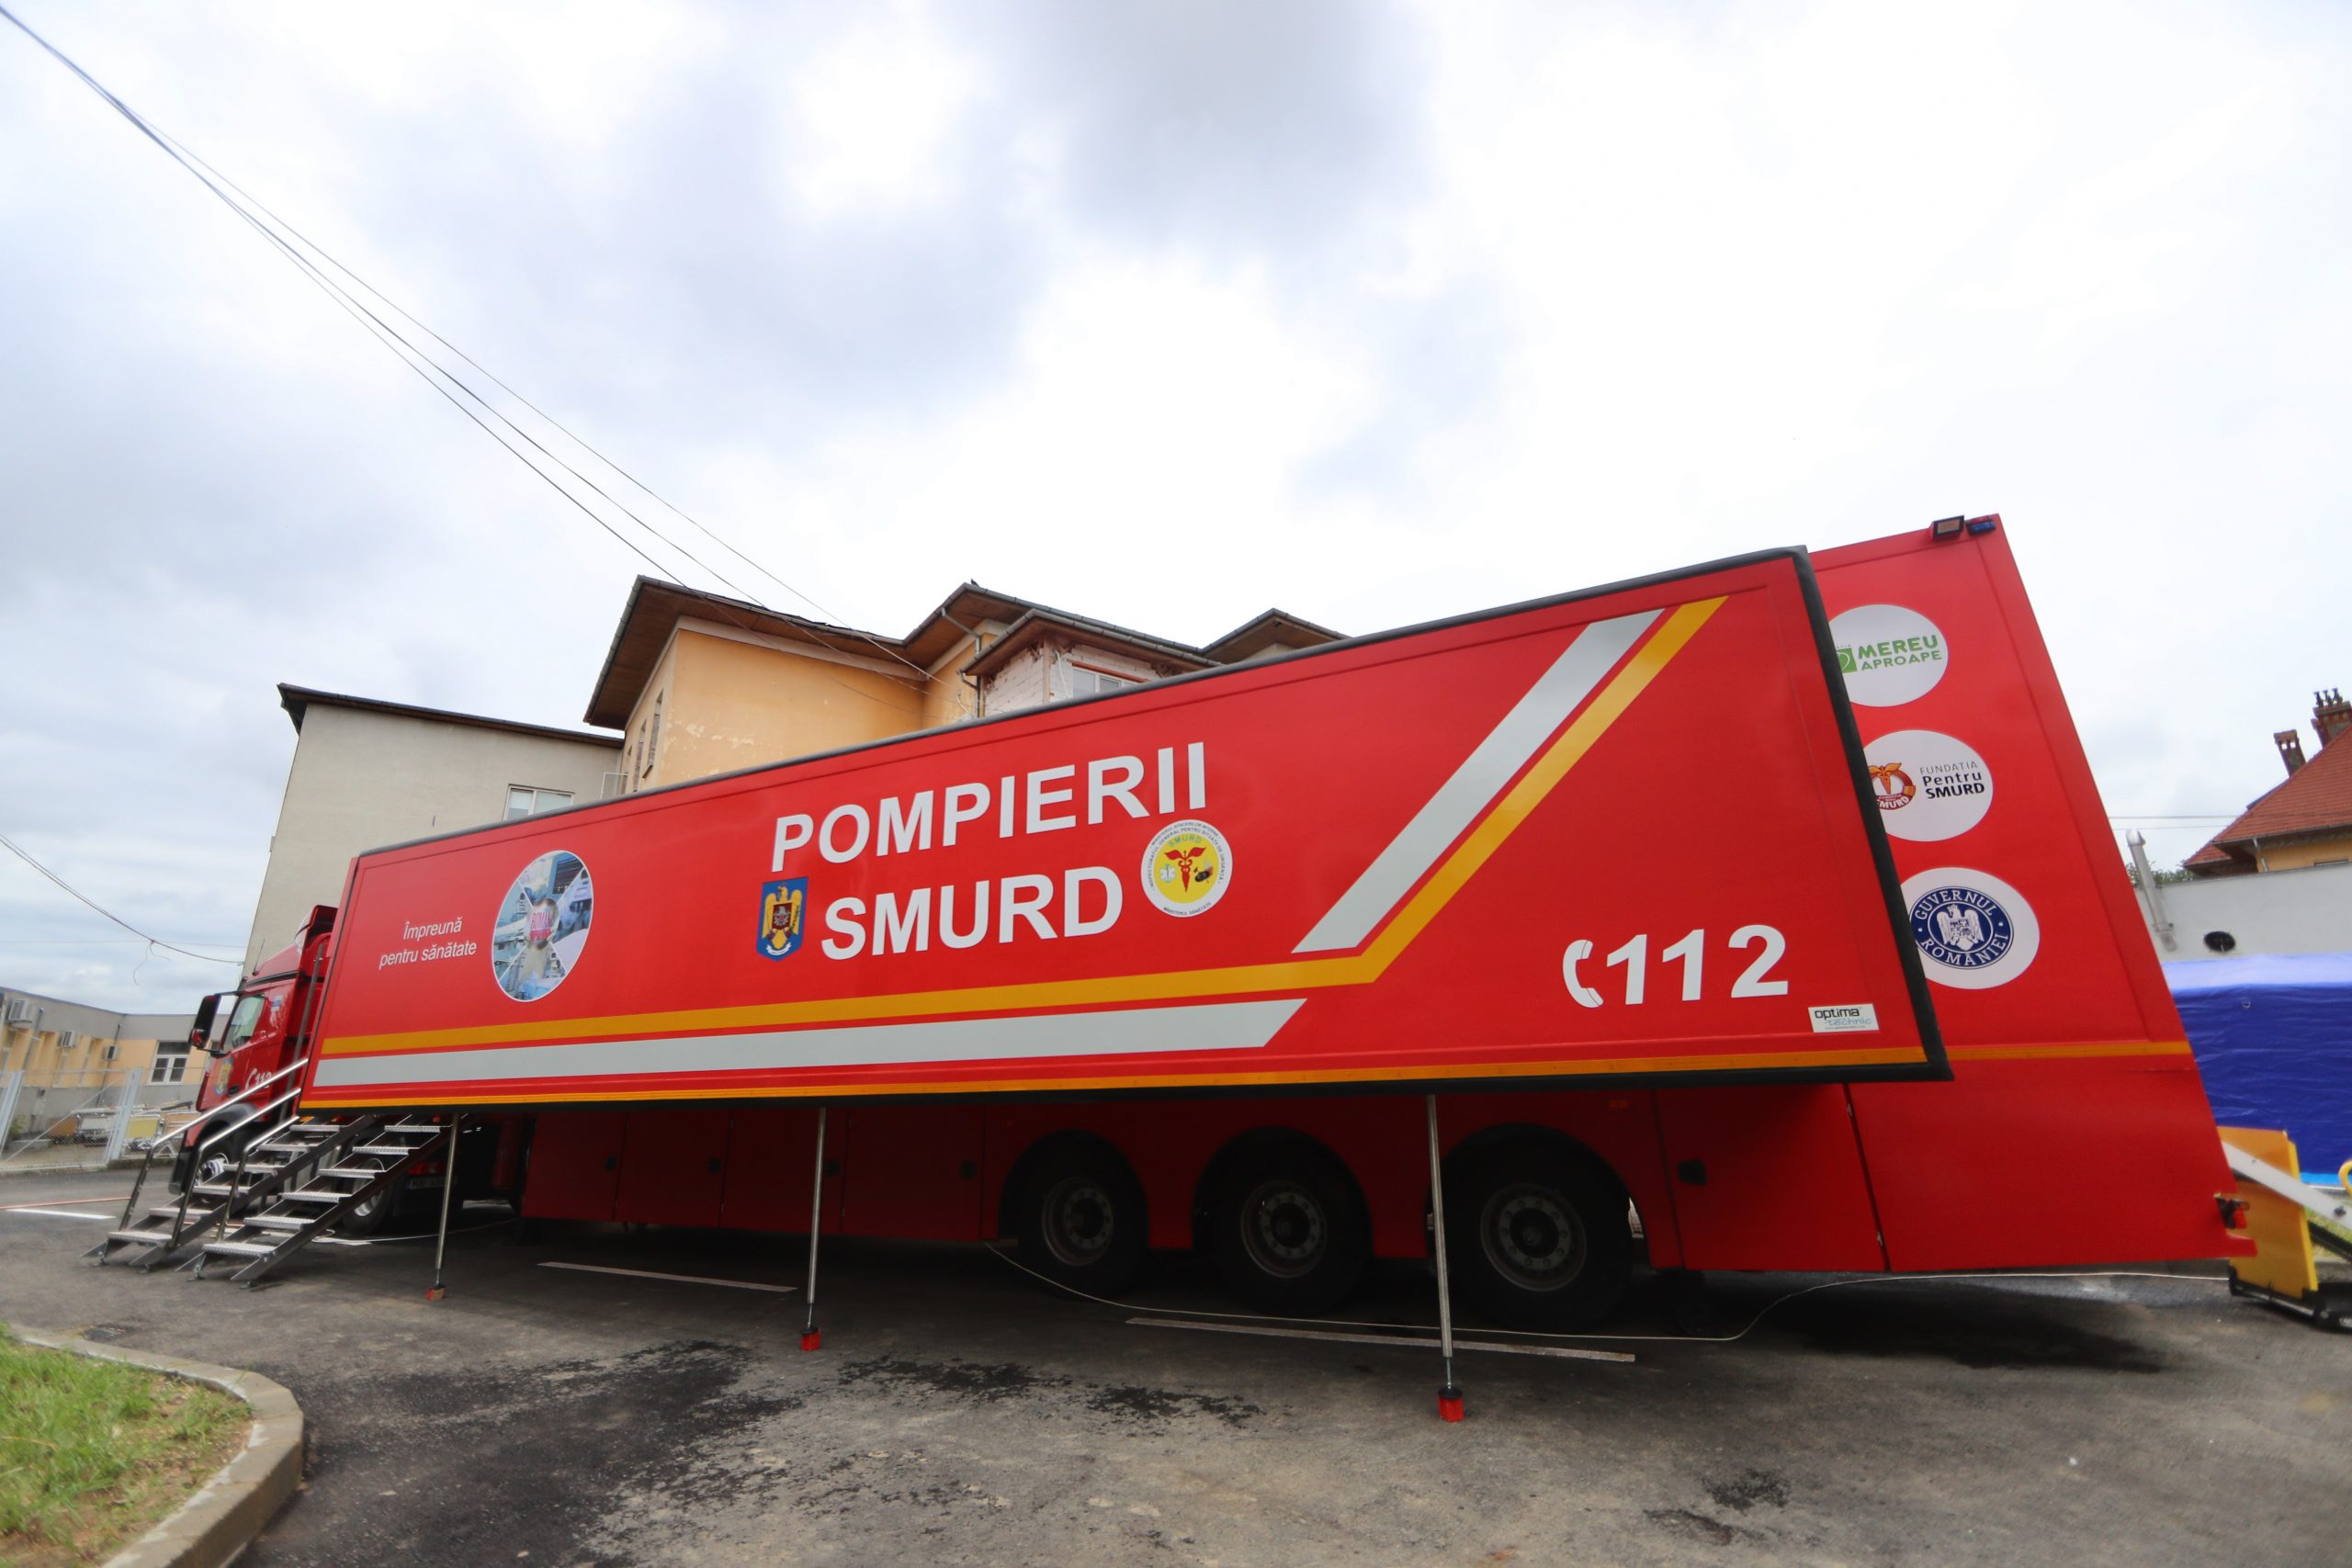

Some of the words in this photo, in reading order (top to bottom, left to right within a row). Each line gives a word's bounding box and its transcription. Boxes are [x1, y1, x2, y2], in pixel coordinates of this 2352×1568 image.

[1858, 635, 1939, 660] MEREU
[1861, 650, 1942, 671] APROAPE
[1922, 772, 1982, 787] Pentru
[1926, 783, 1985, 799] SMURD
[771, 741, 1207, 873] POMPIERII
[1876, 795, 1909, 808] MURD
[1168, 834, 1202, 847] SMURD
[821, 865, 1124, 961] SMURD
[1915, 890, 1997, 919] GUVERNUL
[402, 916, 463, 942] Împreună
[378, 949, 419, 971] pentru
[421, 940, 478, 962] sănătate
[1606, 924, 1789, 1006] 112
[1815, 1008, 1860, 1021] optima
